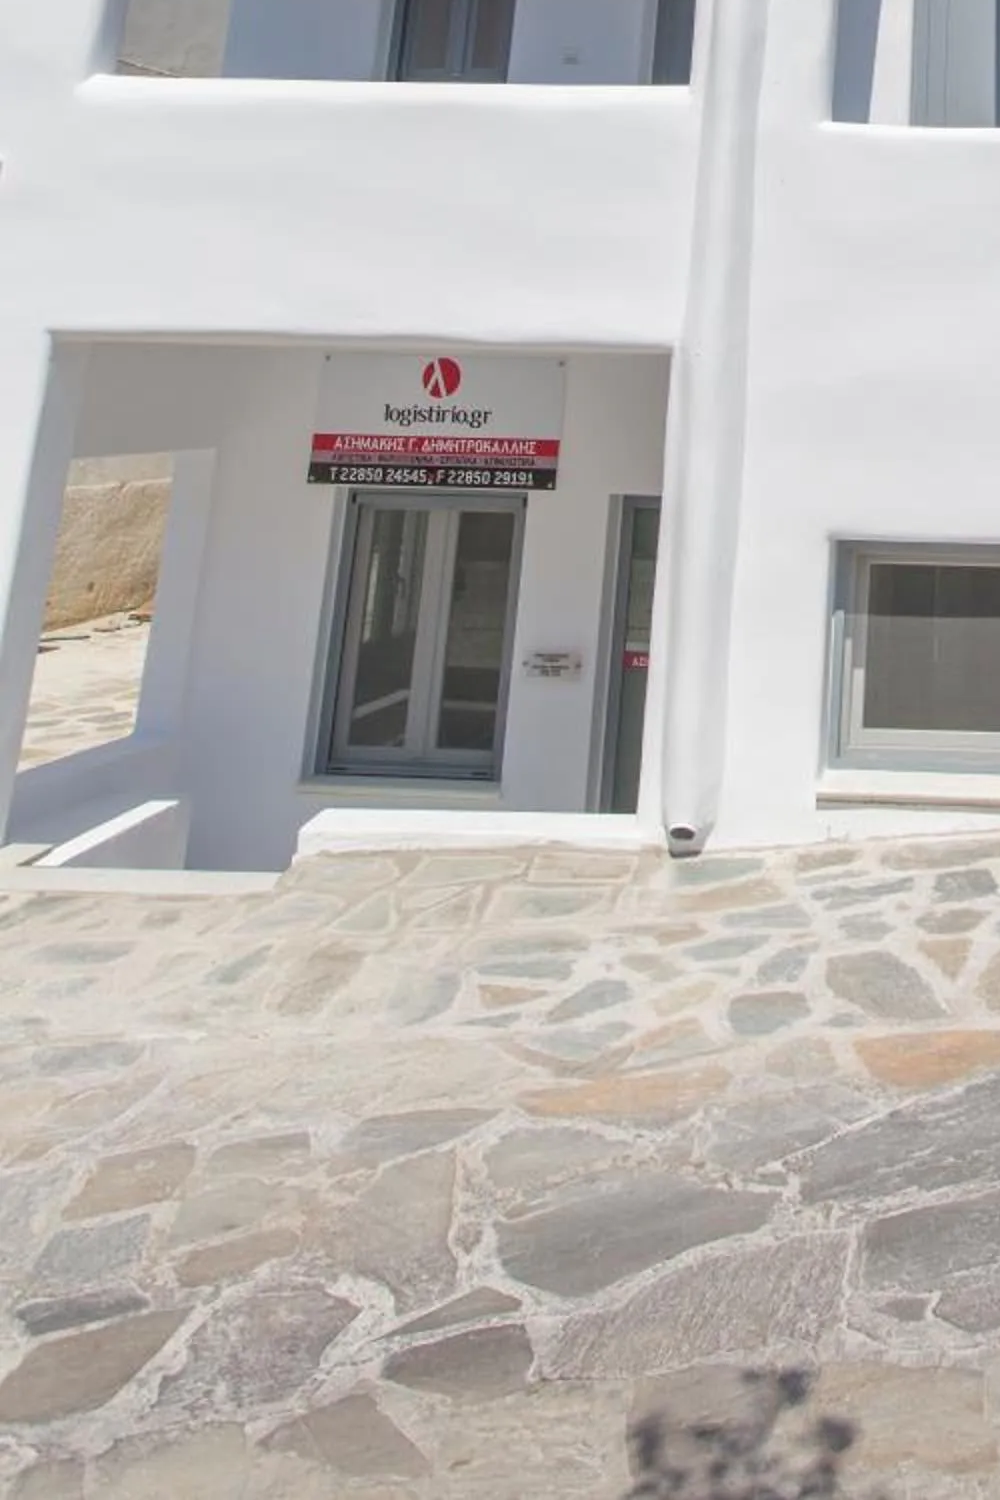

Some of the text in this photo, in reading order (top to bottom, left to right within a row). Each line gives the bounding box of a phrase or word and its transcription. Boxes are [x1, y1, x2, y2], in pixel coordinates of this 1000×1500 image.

[384, 404, 492, 428] logistirio.gr
[333, 435, 405, 451] ΑΣΗΜΑΚΗΣ
[421, 437, 537, 455] ΔΗΜΗΤΡΟΚΑΛΛΗΣ
[339, 467, 383, 482] 22850
[447, 469, 491, 485] 22850
[493, 471, 534, 487] 29191
